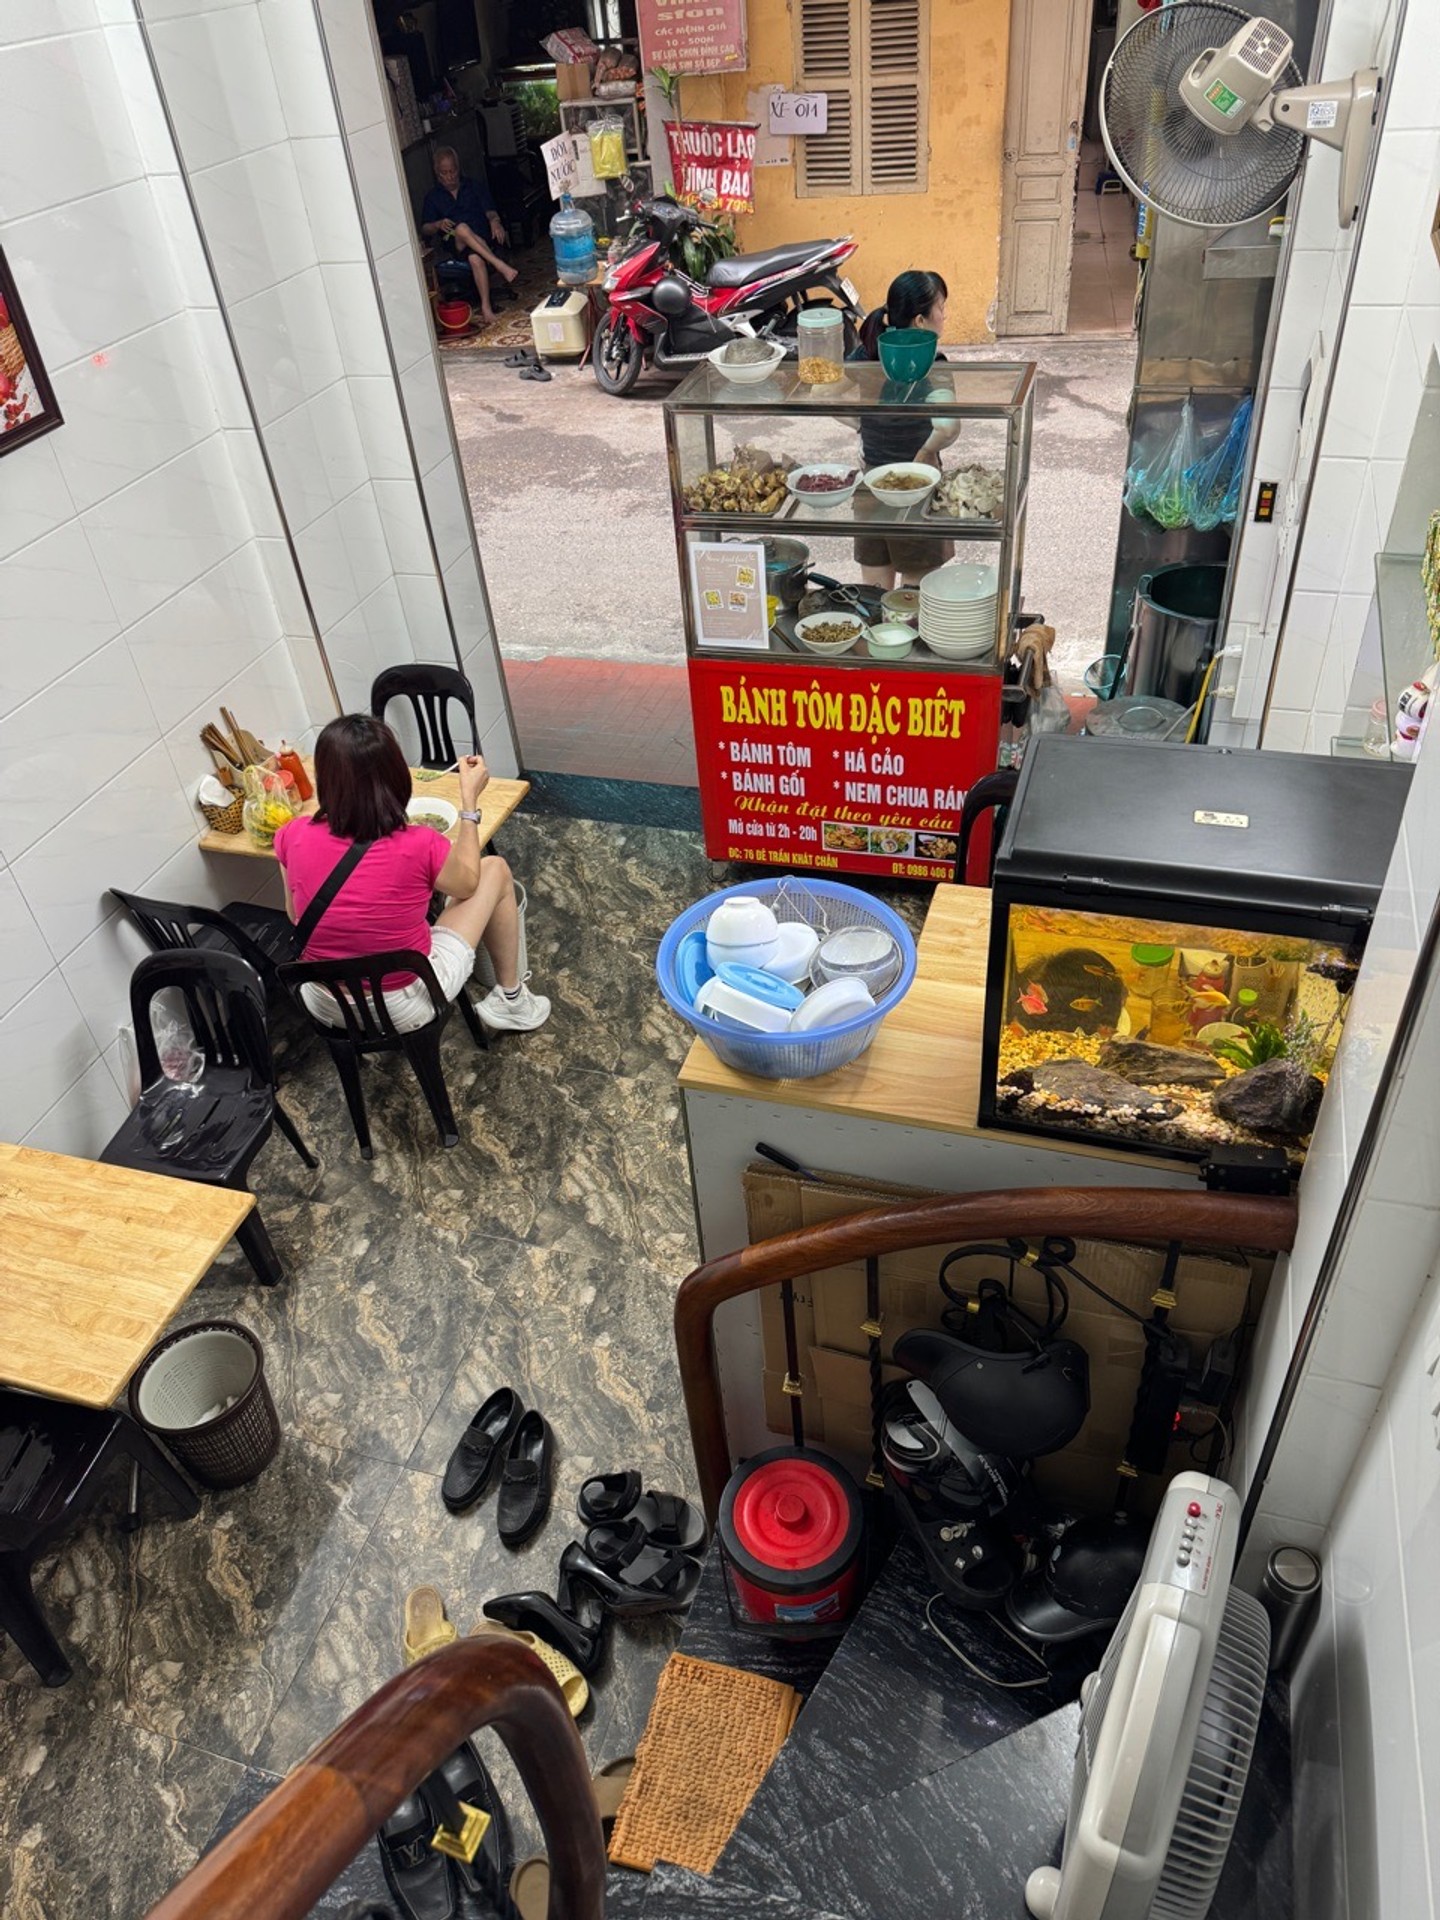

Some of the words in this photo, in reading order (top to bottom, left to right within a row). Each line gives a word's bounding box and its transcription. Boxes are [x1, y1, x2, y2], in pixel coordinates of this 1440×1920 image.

[727, 129, 756, 159] LÀO
[721, 161, 750, 197] BẢO
[721, 675, 787, 727] BÁNH
[792, 679, 844, 731] TÔM
[849, 682, 901, 745] ĐẶC
[730, 738, 774, 765] BÁNH
[777, 742, 811, 768] TÔM
[844, 747, 867, 773] HÁ
[871, 747, 905, 776] CẢO
[732, 768, 775, 794] BÁNH
[779, 769, 805, 797] GỐI
[845, 782, 882, 804] NEM
[886, 785, 930, 809] CHUA
[933, 785, 968, 811] RÁN
[735, 795, 790, 816] Nhận
[796, 801, 828, 820] đặt
[833, 805, 872, 823] theo
[879, 812, 913, 827] yêu
[728, 818, 743, 835] Mở
[778, 824, 790, 839] 2h
[799, 826, 817, 841] 20h
